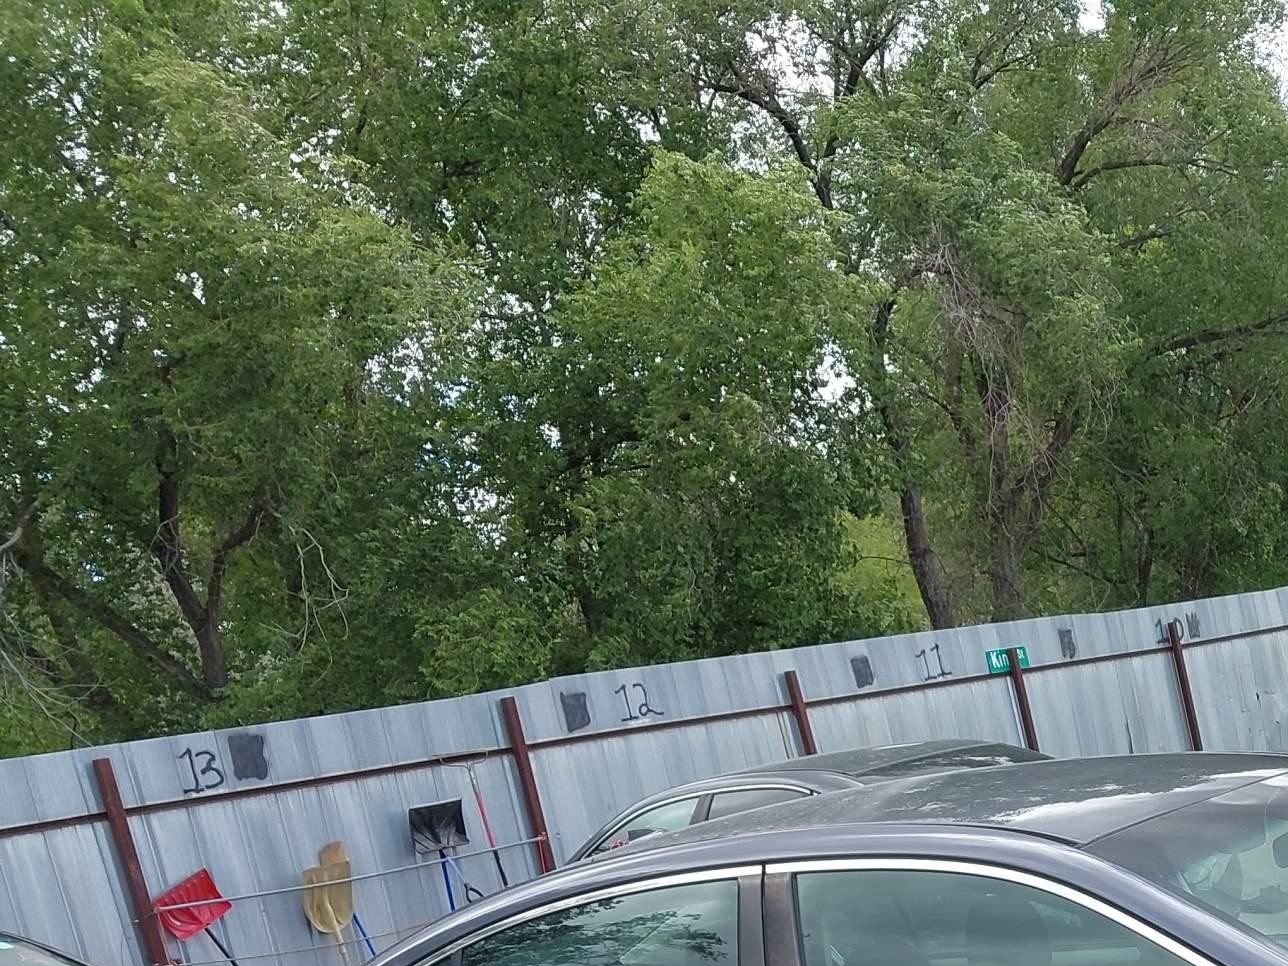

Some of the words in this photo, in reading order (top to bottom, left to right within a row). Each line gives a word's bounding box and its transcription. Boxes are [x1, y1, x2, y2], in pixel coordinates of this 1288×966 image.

[915, 643, 953, 681] 11
[989, 650, 1011, 669] Kin
[614, 683, 665, 722] 12
[176, 747, 225, 794] 13
